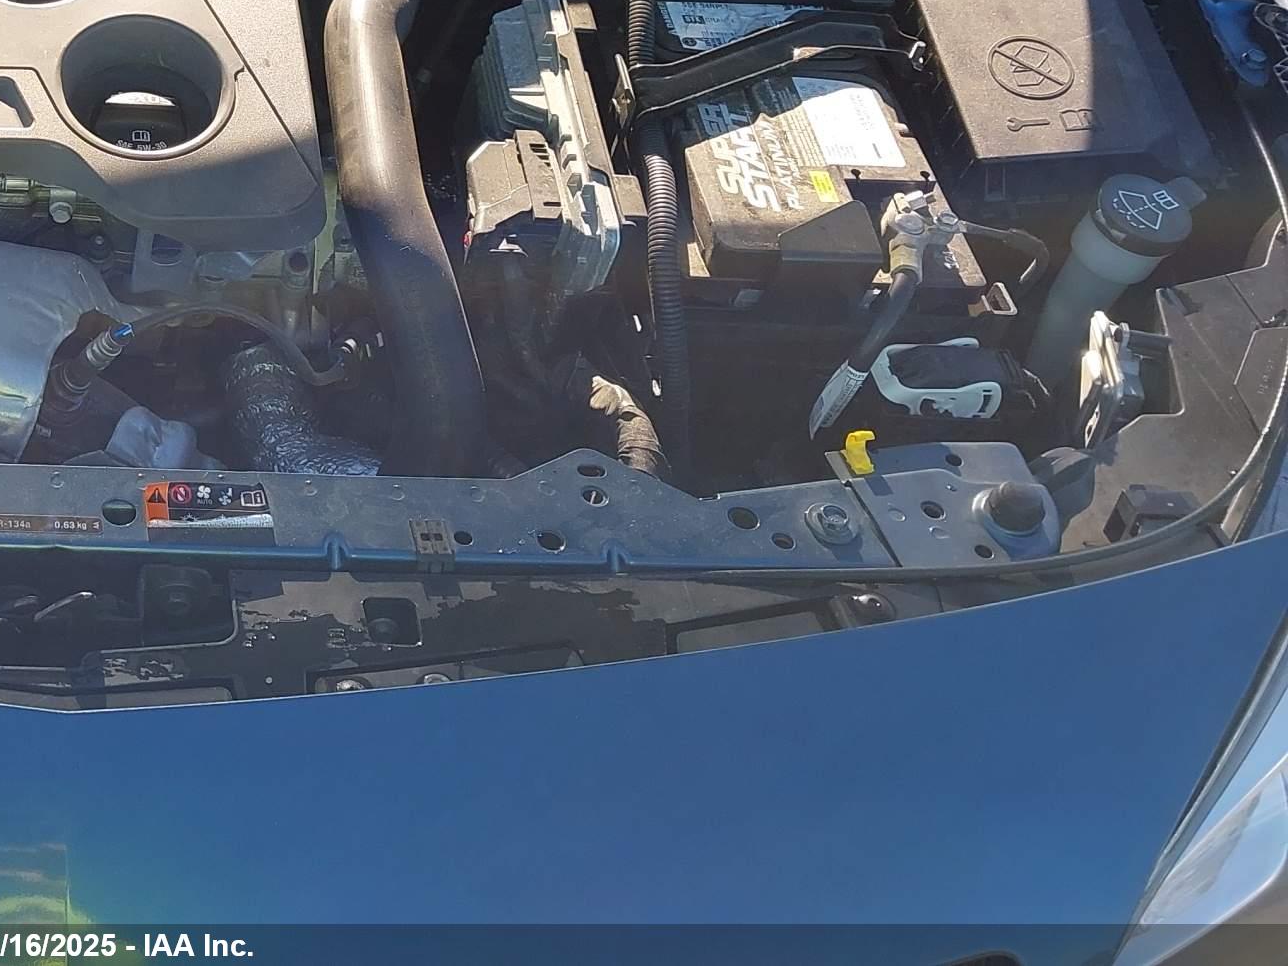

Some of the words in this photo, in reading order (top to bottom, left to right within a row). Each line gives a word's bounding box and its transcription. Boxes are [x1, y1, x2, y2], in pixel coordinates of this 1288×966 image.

[697, 102, 745, 194] SUPER
[725, 105, 782, 213] START
[755, 120, 806, 211] PLATINUM
[54, 520, 75, 529] 0.63
[77, 521, 87, 530] kg
